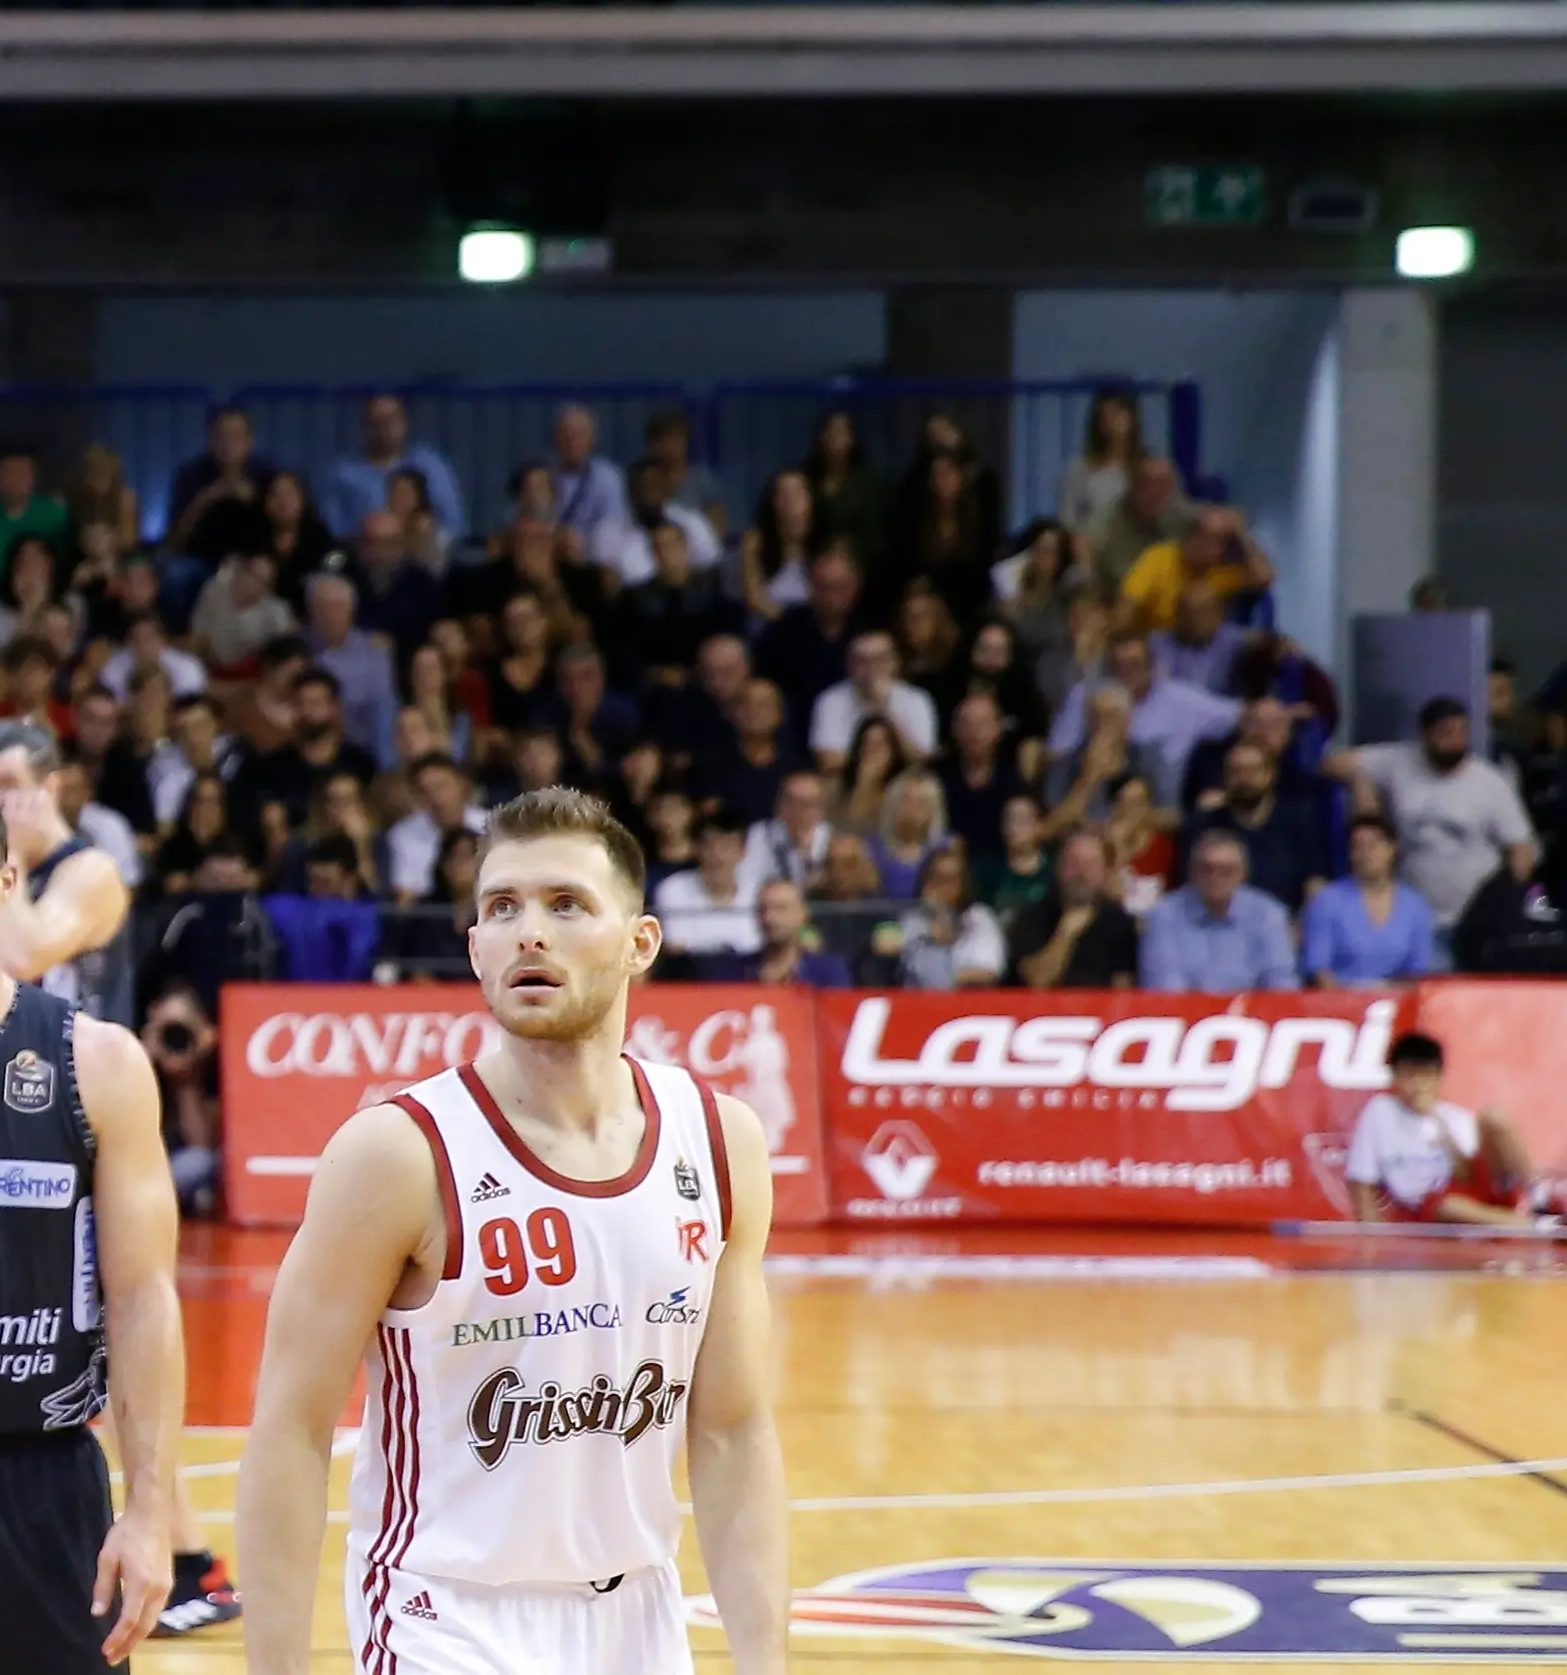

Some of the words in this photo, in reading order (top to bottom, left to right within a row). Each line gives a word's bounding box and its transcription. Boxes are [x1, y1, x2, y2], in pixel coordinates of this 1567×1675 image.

[245, 1011, 499, 1077] CONFO
[841, 996, 1396, 1112] Lasagni
[12, 1082, 46, 1098] LBA
[471, 1187, 511, 1203] adidas
[478, 1206, 577, 1296] 99
[401, 1605, 438, 1621] adidas
